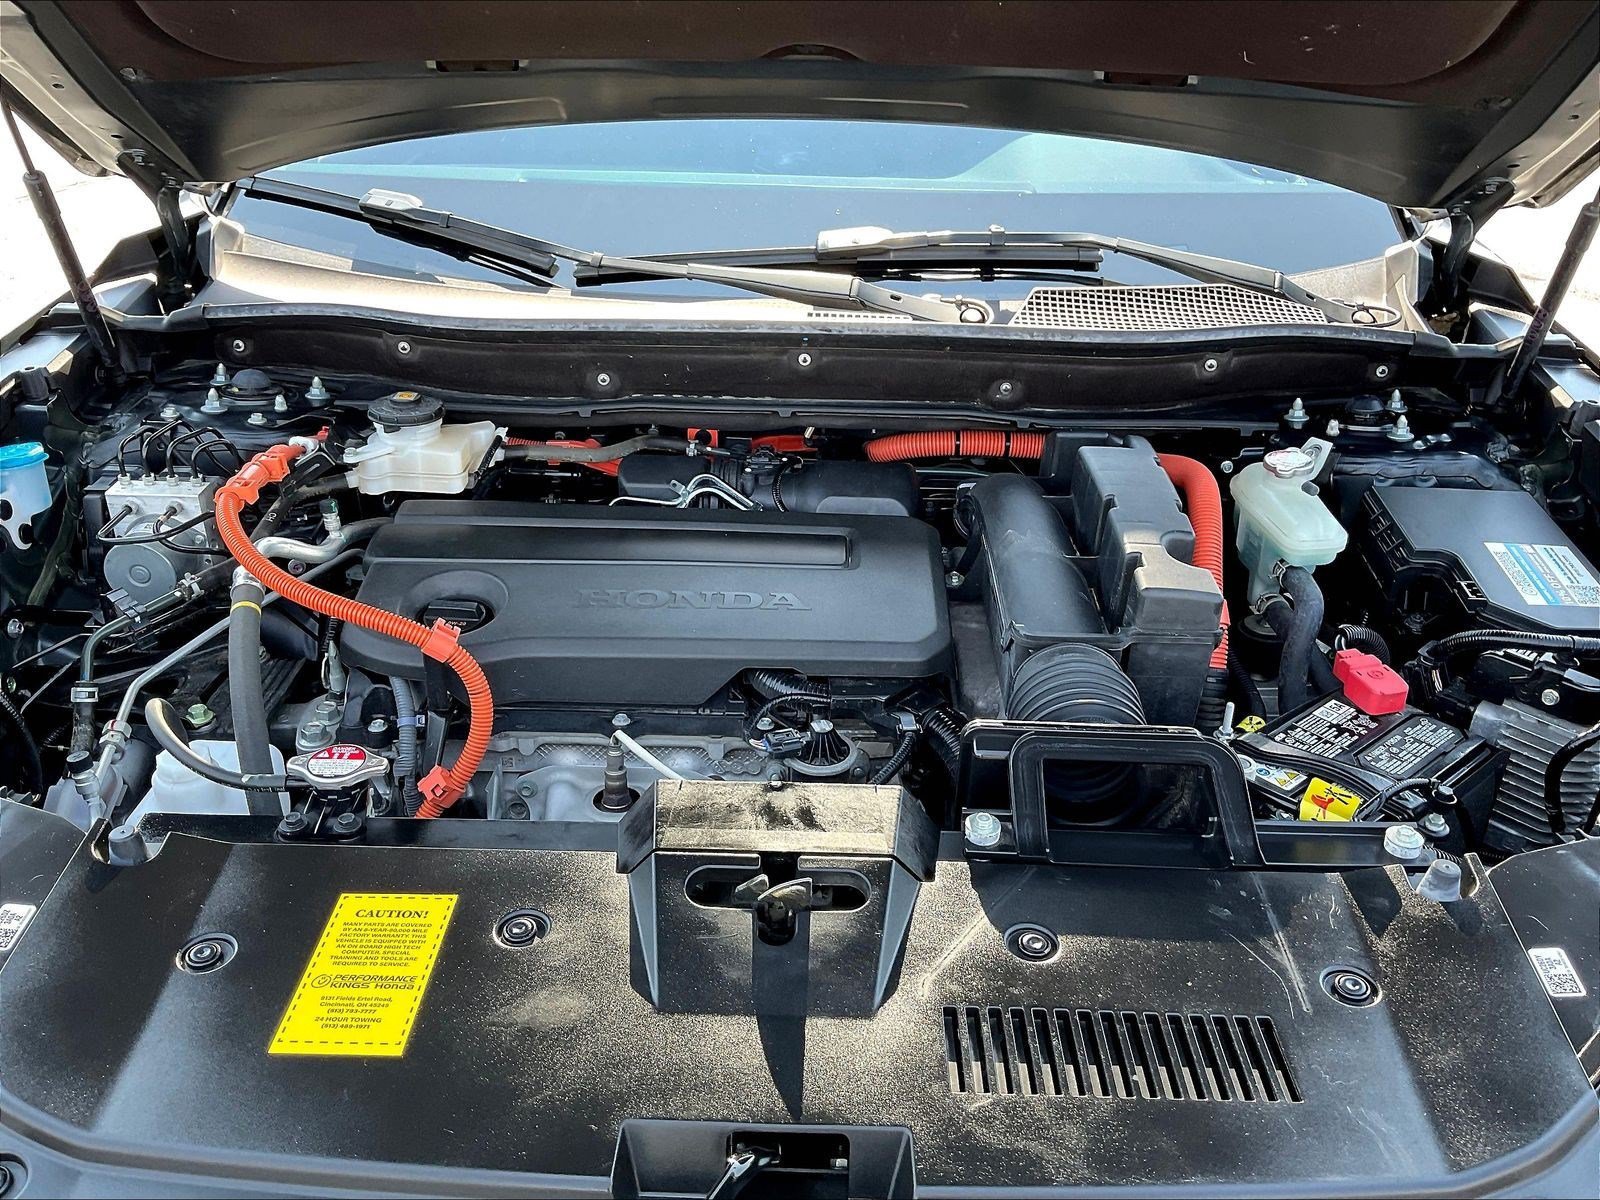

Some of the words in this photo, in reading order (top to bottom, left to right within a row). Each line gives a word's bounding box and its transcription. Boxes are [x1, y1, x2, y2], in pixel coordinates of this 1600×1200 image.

[574, 589, 812, 611] HONDA
[355, 910, 429, 919] CAUTION!
[333, 974, 418, 982] PERFORMANCE
